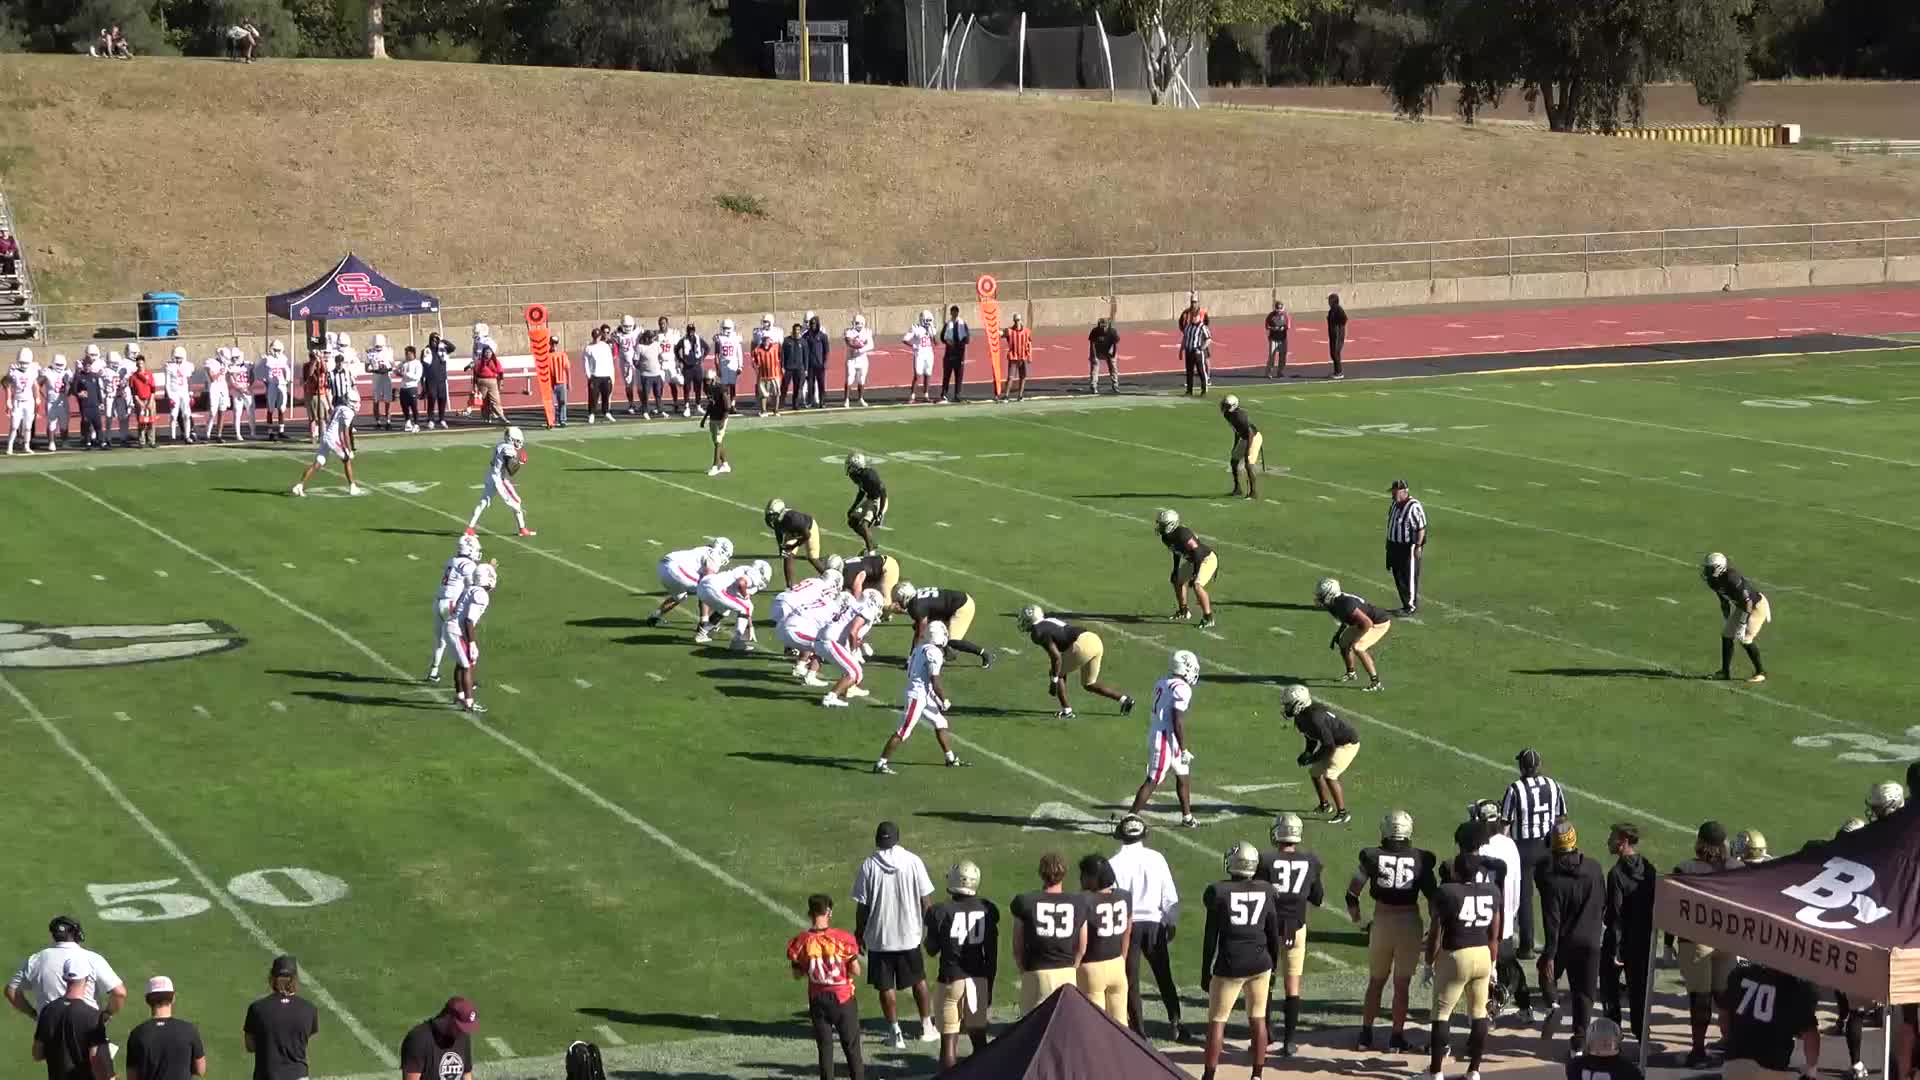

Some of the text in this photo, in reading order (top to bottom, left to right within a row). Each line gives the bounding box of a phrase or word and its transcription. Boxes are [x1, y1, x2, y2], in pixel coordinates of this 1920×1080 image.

[1531, 787, 1549, 812] L
[1272, 859, 1309, 894] 37
[1377, 855, 1416, 889] 56
[86, 867, 349, 922] 50
[1230, 892, 1266, 926] 57
[1458, 896, 1494, 927] 45
[950, 910, 985, 945] 40
[1036, 902, 1074, 938] 53
[1096, 900, 1128, 937] 33
[1679, 899, 1858, 975] ROADRUNNERS
[1735, 978, 1777, 1024] 70
